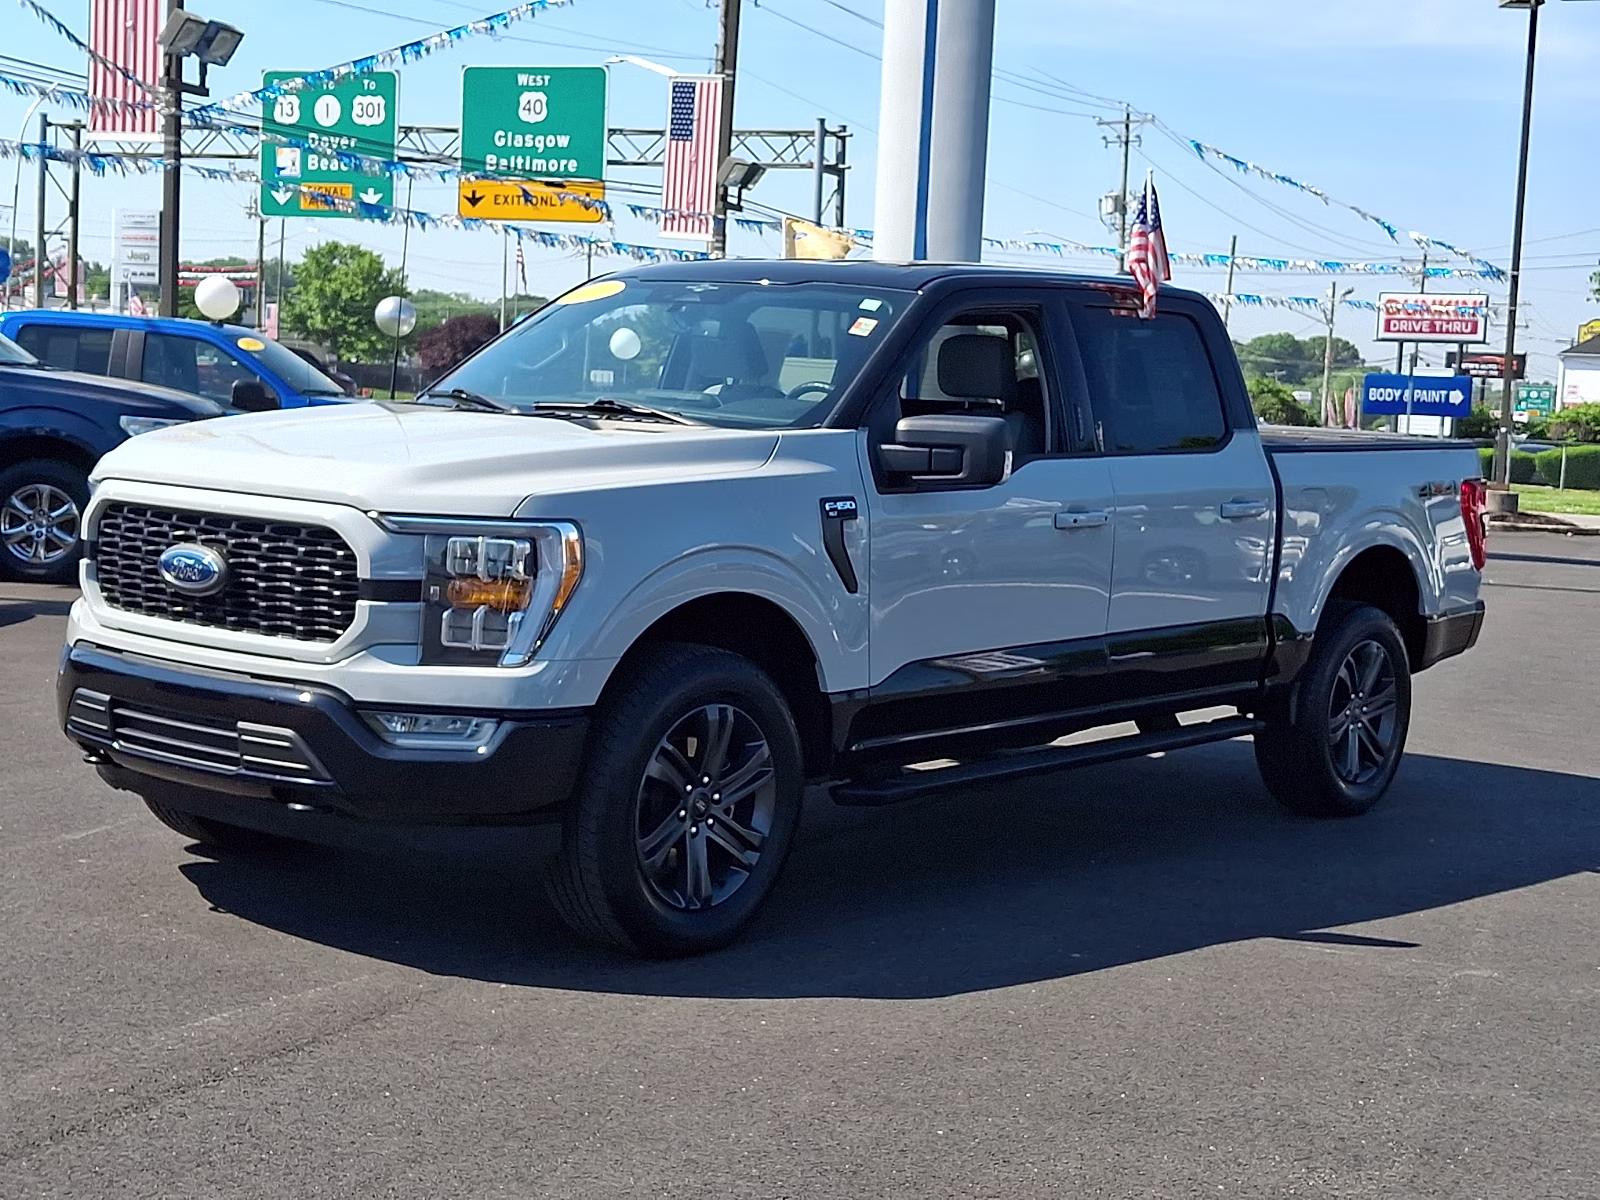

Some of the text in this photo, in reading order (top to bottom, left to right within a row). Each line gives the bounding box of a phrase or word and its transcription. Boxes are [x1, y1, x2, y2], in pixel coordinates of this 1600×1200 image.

[363, 79, 376, 90] TO
[517, 73, 551, 86] WEST
[279, 101, 294, 117] 13
[356, 102, 381, 118] 301
[522, 98, 543, 115] 40
[308, 132, 358, 149] Dover
[493, 129, 571, 153] Glasgow
[485, 154, 578, 172] Baltimore
[493, 194, 522, 206] EXIT
[127, 250, 150, 262] Jeep
[1389, 320, 1472, 333] DRIVE THRU
[1368, 387, 1402, 402] BODY
[1413, 389, 1448, 404] PAINT
